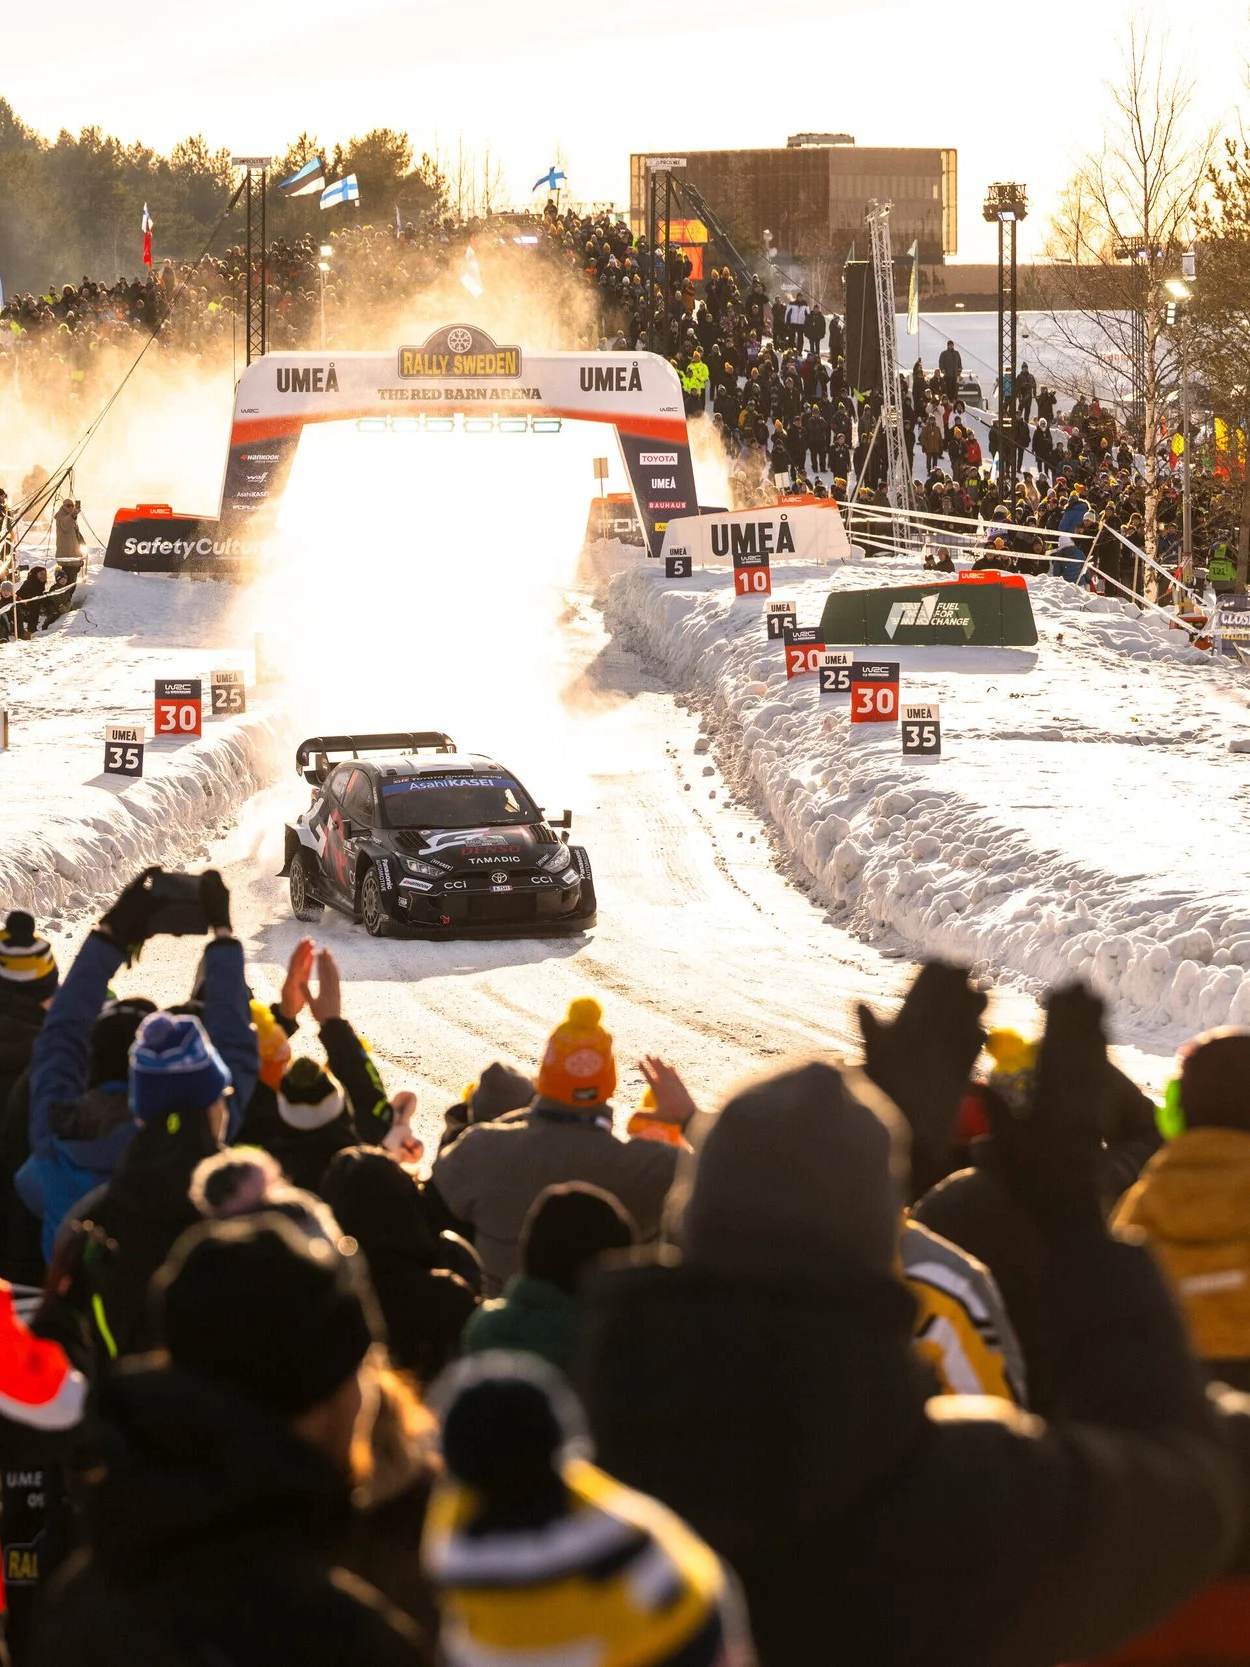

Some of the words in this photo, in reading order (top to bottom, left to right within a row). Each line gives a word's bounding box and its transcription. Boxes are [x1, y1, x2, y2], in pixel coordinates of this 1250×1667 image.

[403, 351, 449, 375] RALLY
[453, 351, 516, 374] SWEDEN
[276, 362, 339, 393] UMEÅ
[580, 361, 642, 392] UMEÅ
[377, 388, 410, 400] THE
[410, 388, 442, 400] RED
[444, 388, 487, 400] BARN
[489, 388, 542, 400] ARENA
[651, 476, 676, 489] UMEÅ
[711, 514, 795, 556] UMEÅ
[669, 547, 687, 556] UMEÅ
[674, 561, 684, 575] 5
[739, 571, 767, 592] 10
[771, 603, 791, 612] UMEÅ
[936, 602, 960, 610] FUEL
[933, 610, 954, 618] FOR
[770, 617, 794, 634] 15
[930, 618, 970, 626] CHANGE
[790, 649, 820, 673] 20
[825, 655, 847, 665] UMEÅ
[216, 674, 239, 683] UMEÅ
[823, 670, 850, 690] 25
[215, 689, 242, 708] 25
[856, 688, 894, 714] 30
[160, 705, 197, 731] 30
[907, 708, 932, 719] UMEÅ
[112, 728, 137, 741] UMEÅ
[906, 726, 936, 748] 35
[109, 747, 139, 769] 35
[409, 779, 494, 790] AsahiKASEI
[462, 846, 520, 856] DENSO
[468, 856, 521, 864] TAMADIC
[381, 859, 393, 890] Panasonic
[6, 1471, 44, 1488] UME
